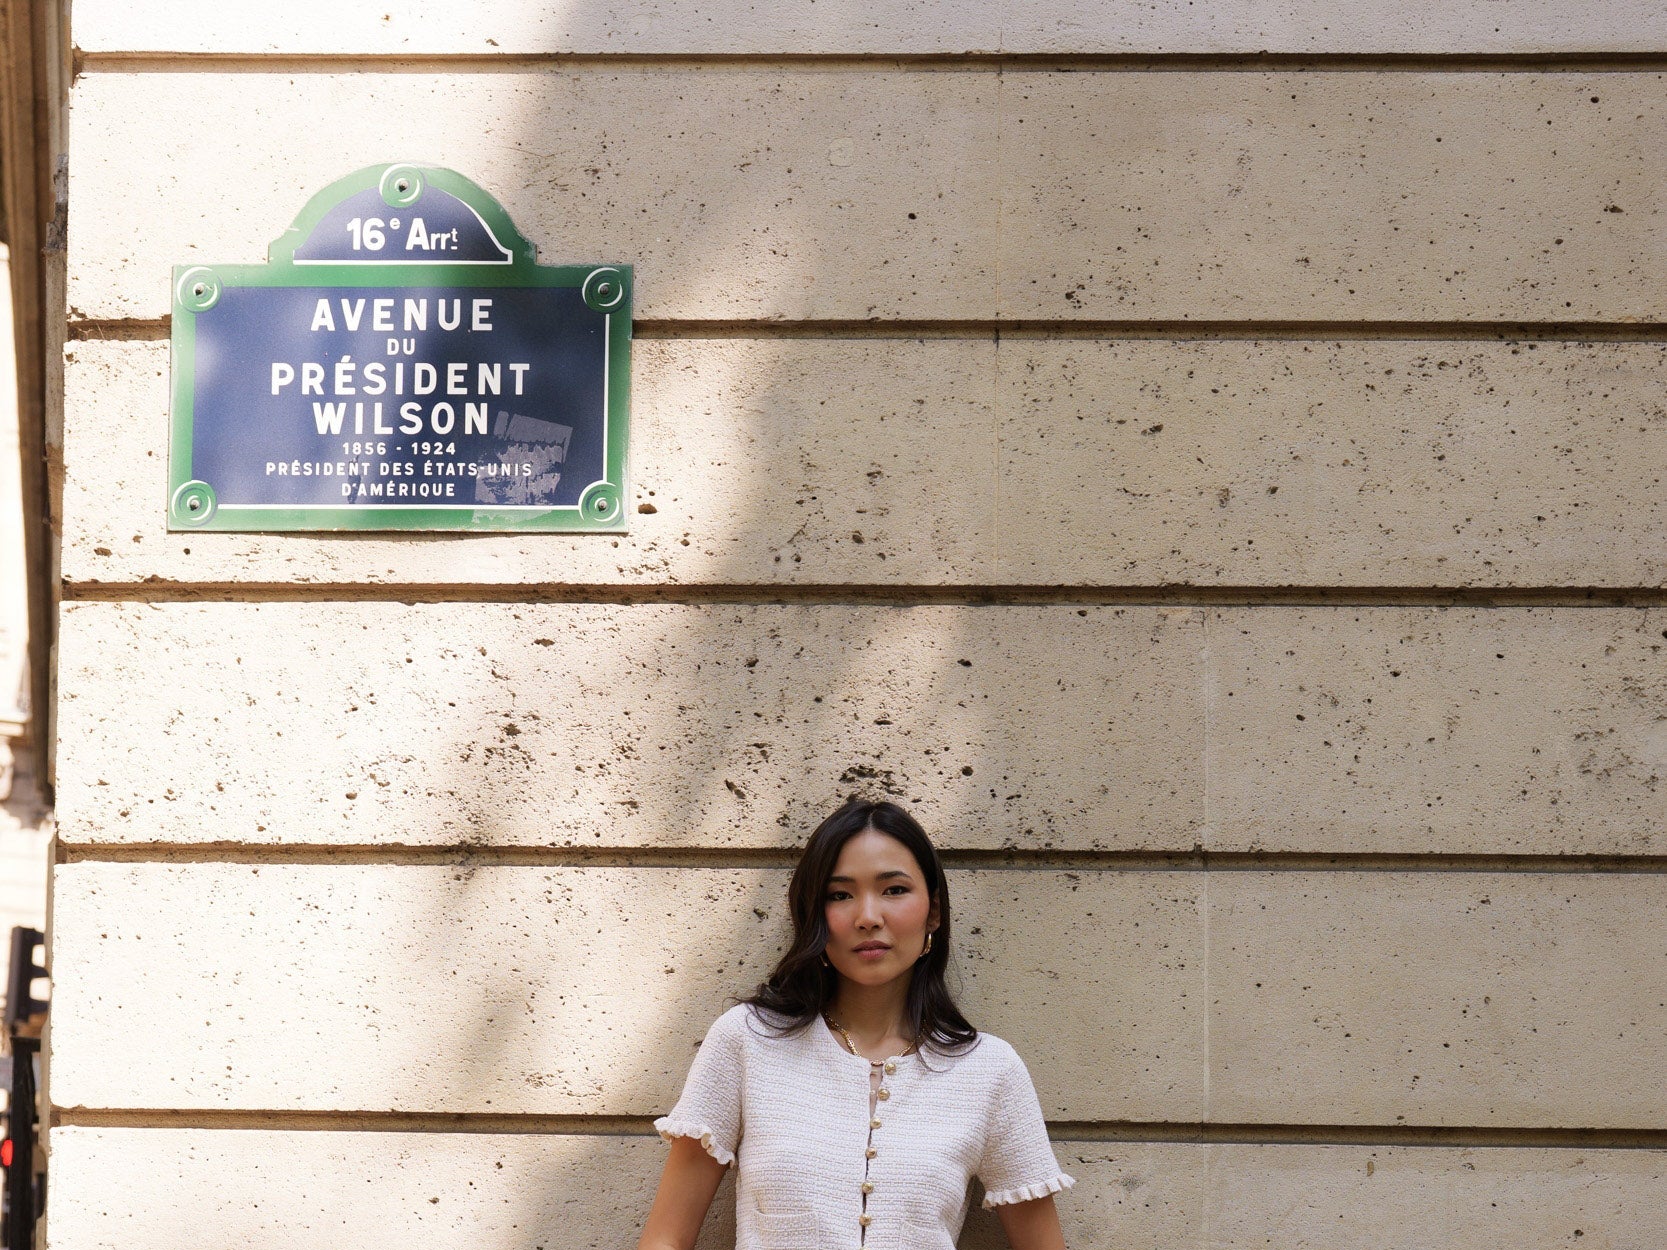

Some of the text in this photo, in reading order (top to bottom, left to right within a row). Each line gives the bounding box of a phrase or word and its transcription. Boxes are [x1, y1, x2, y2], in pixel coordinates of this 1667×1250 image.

[311, 298, 494, 332] AVENUE
[387, 338, 416, 356] DU
[271, 355, 531, 396] PRÉSIDENT
[312, 402, 489, 435] WILSON
[342, 442, 387, 456] 1856
[411, 442, 456, 456] 1924
[266, 459, 532, 477] PRÉSIDENT DES ÉTATS-UNIS
[341, 481, 455, 498] D'AMÉRIQUE
